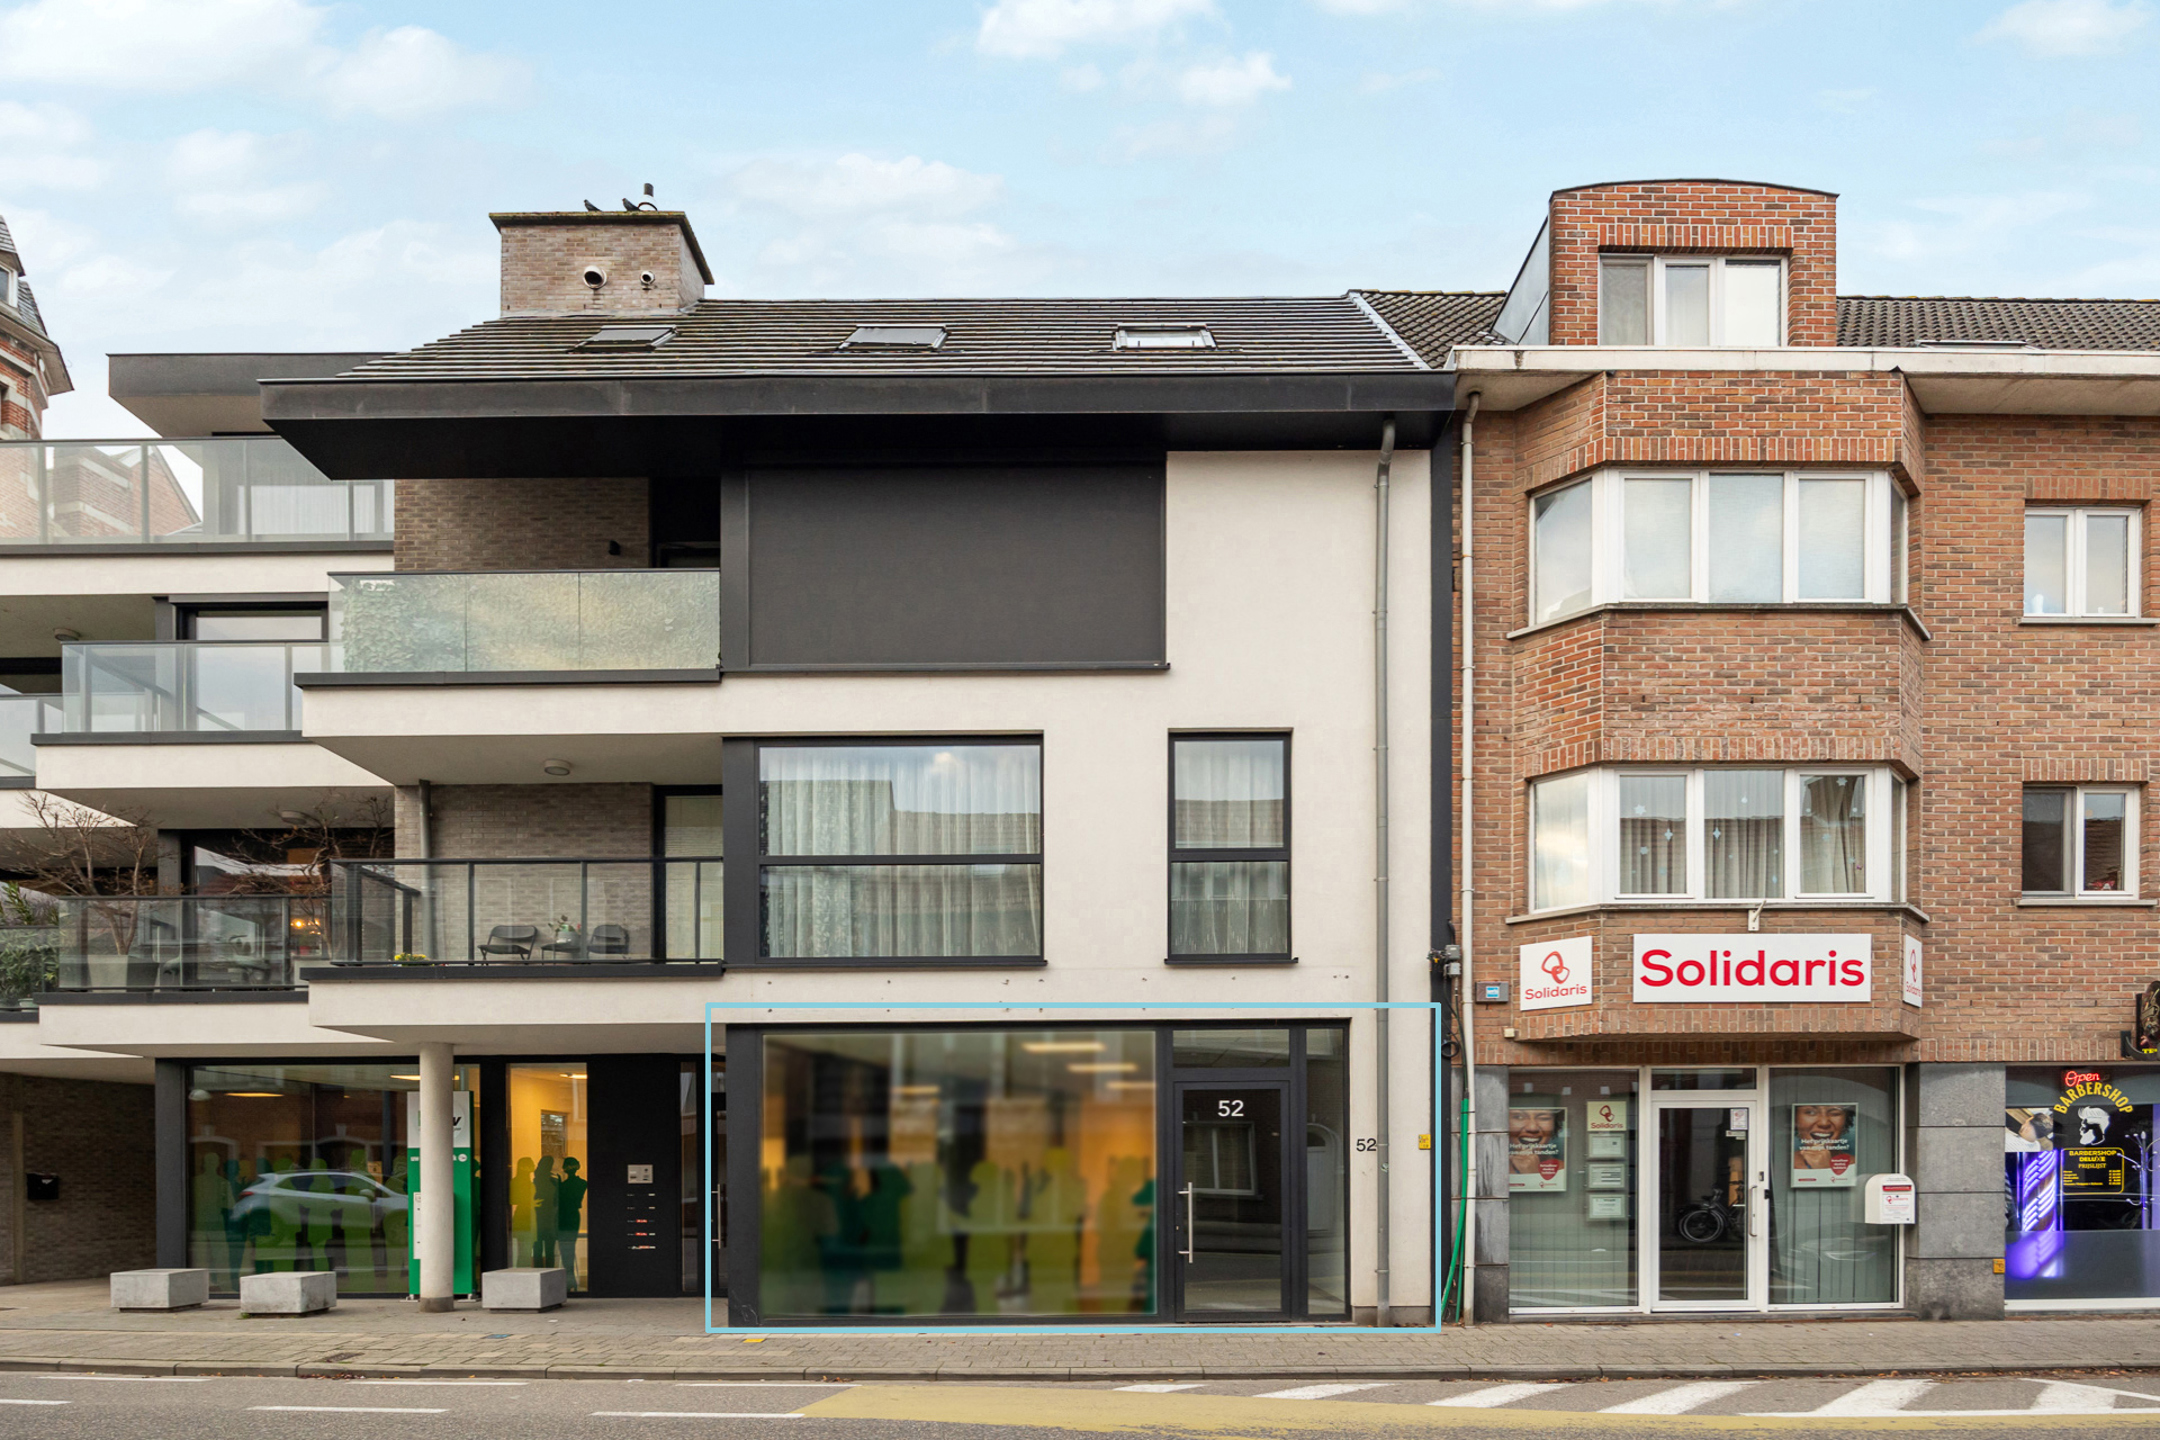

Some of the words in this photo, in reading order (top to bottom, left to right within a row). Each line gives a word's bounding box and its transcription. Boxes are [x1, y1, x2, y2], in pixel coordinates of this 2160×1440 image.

[1640, 949, 1865, 987] Solidaris
[1525, 984, 1588, 1000] Solidaris
[2064, 1070, 2101, 1087] Open
[2053, 1081, 2133, 1114] BARBERSHOP
[1217, 1100, 1244, 1117] 52
[1356, 1138, 1377, 1152] 52
